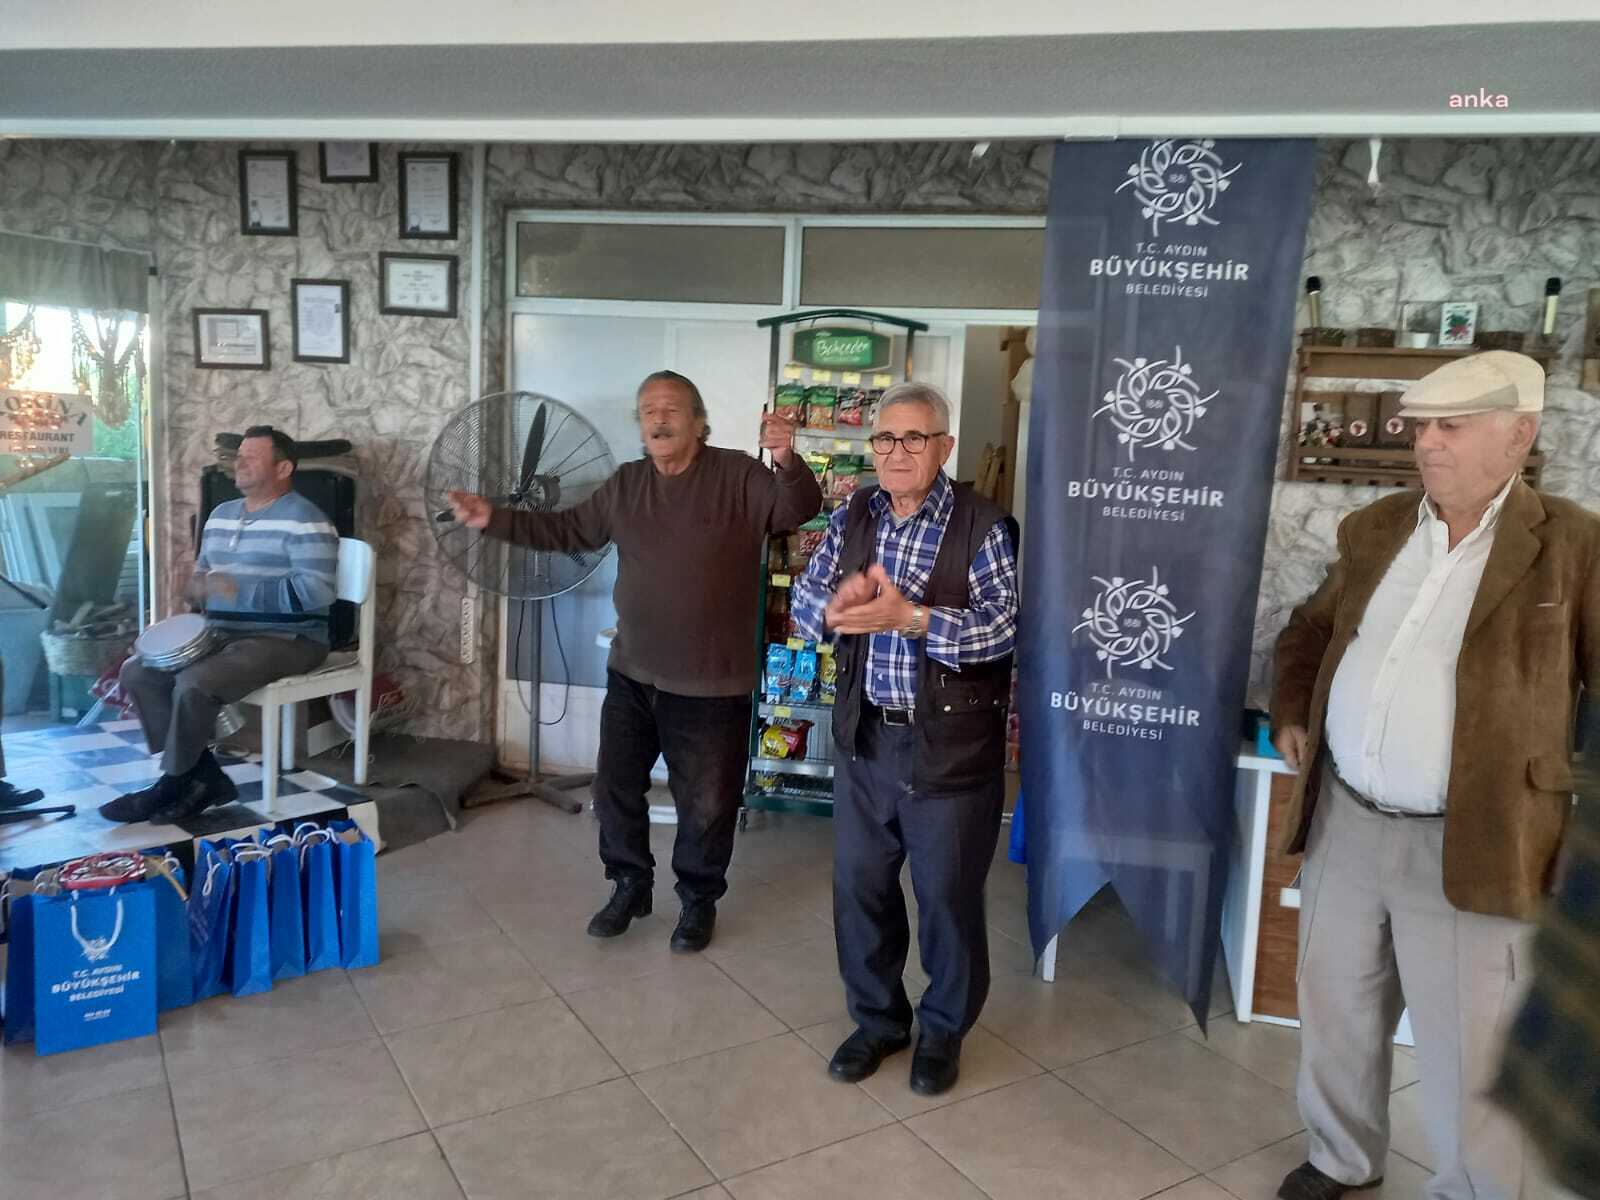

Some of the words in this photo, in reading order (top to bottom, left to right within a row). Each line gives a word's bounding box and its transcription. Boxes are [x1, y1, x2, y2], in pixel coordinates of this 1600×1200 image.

[1136, 242, 1161, 255] T.C.
[1164, 244, 1207, 257] AYDIN
[1089, 255, 1249, 283] BÜYÜKŞEHİR
[1125, 283, 1208, 298] BELEDİYESİ
[1112, 467, 1137, 479] T.C.
[1140, 468, 1184, 482] AYDIN
[1067, 478, 1224, 508] BÜYÜKŞEHİR
[1102, 505, 1185, 522] BELEDİYESİ
[1090, 682, 1115, 696] T.C.
[1118, 686, 1162, 701] AYDIN
[1050, 691, 1200, 727] BÜYÜKŞEHİR
[1083, 719, 1163, 741] BELEDİYESİ
